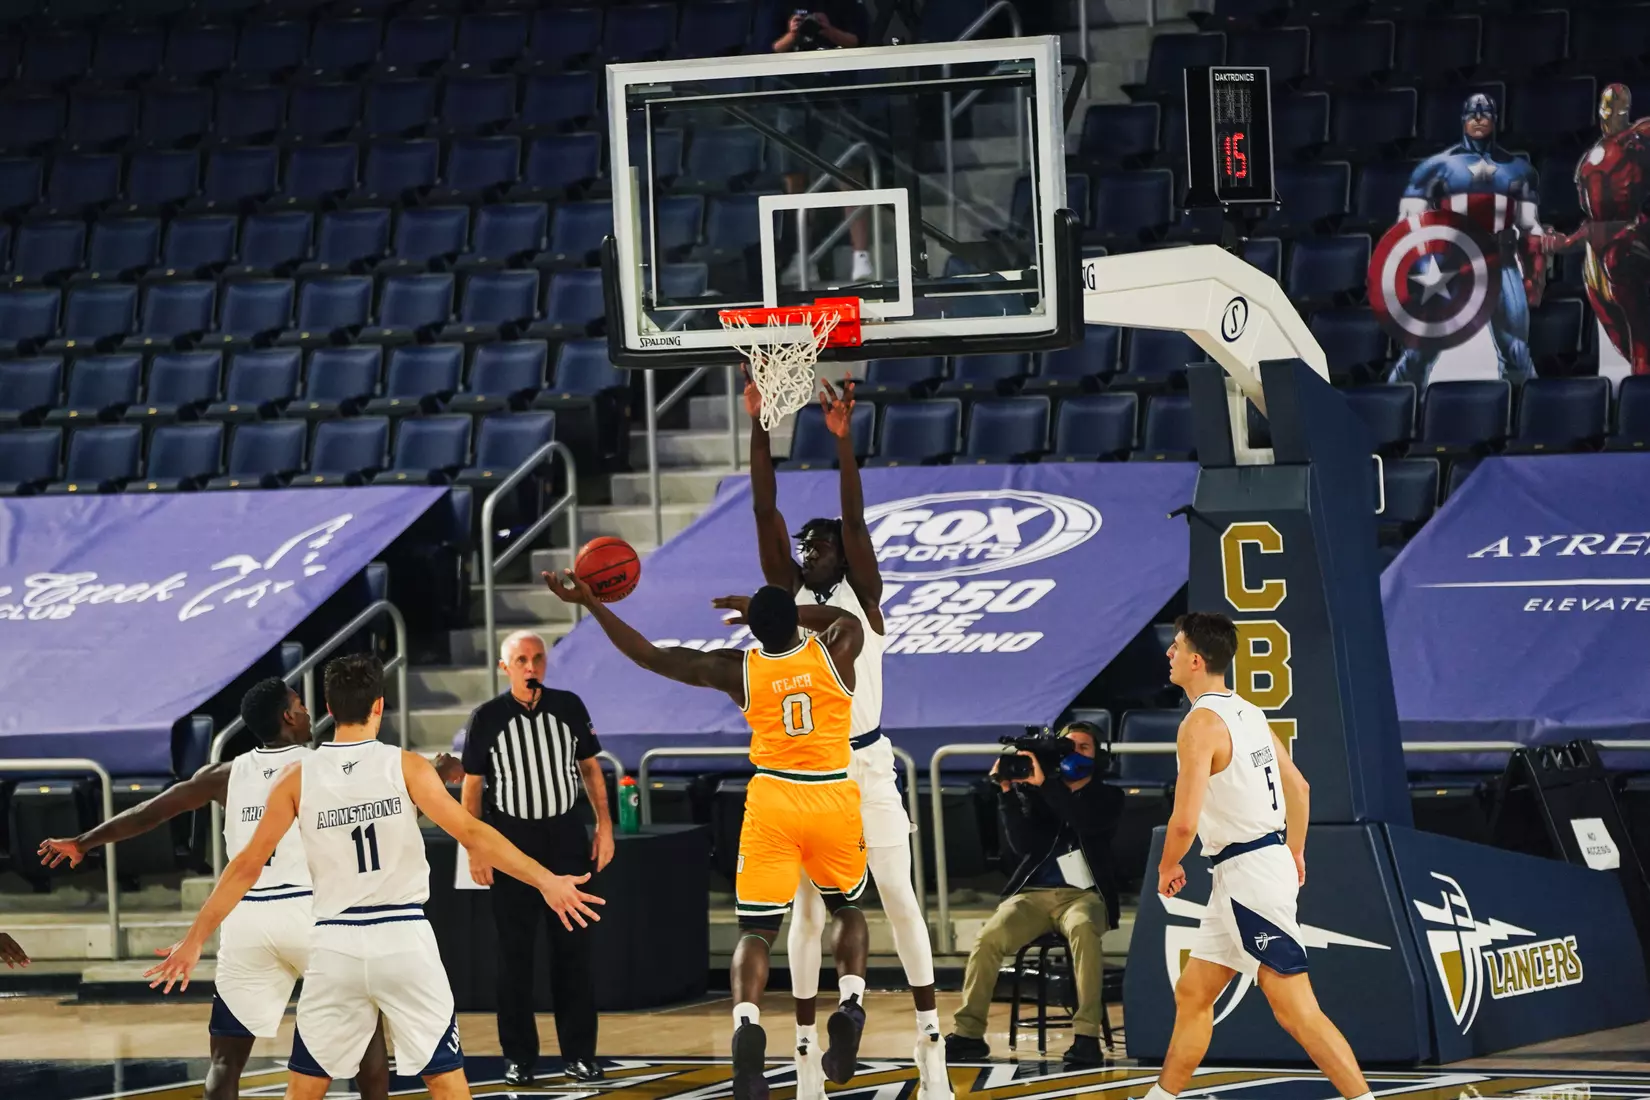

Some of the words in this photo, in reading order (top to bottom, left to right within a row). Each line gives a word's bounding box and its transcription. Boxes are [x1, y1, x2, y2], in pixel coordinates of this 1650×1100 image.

[1214, 73, 1255, 82] DAKTRONICS
[1223, 132, 1247, 178] 15
[640, 336, 681, 348] SPALDING
[870, 507, 1049, 547] FOX
[1467, 532, 1650, 558] AYRE
[874, 543, 1020, 563] PORTS
[24, 571, 188, 607] Creek
[781, 692, 815, 737] 0
[1264, 766, 1278, 811] 5
[317, 797, 402, 829] ARMSTRONG
[351, 822, 381, 873] 11
[1482, 935, 1583, 999] LANCERS
